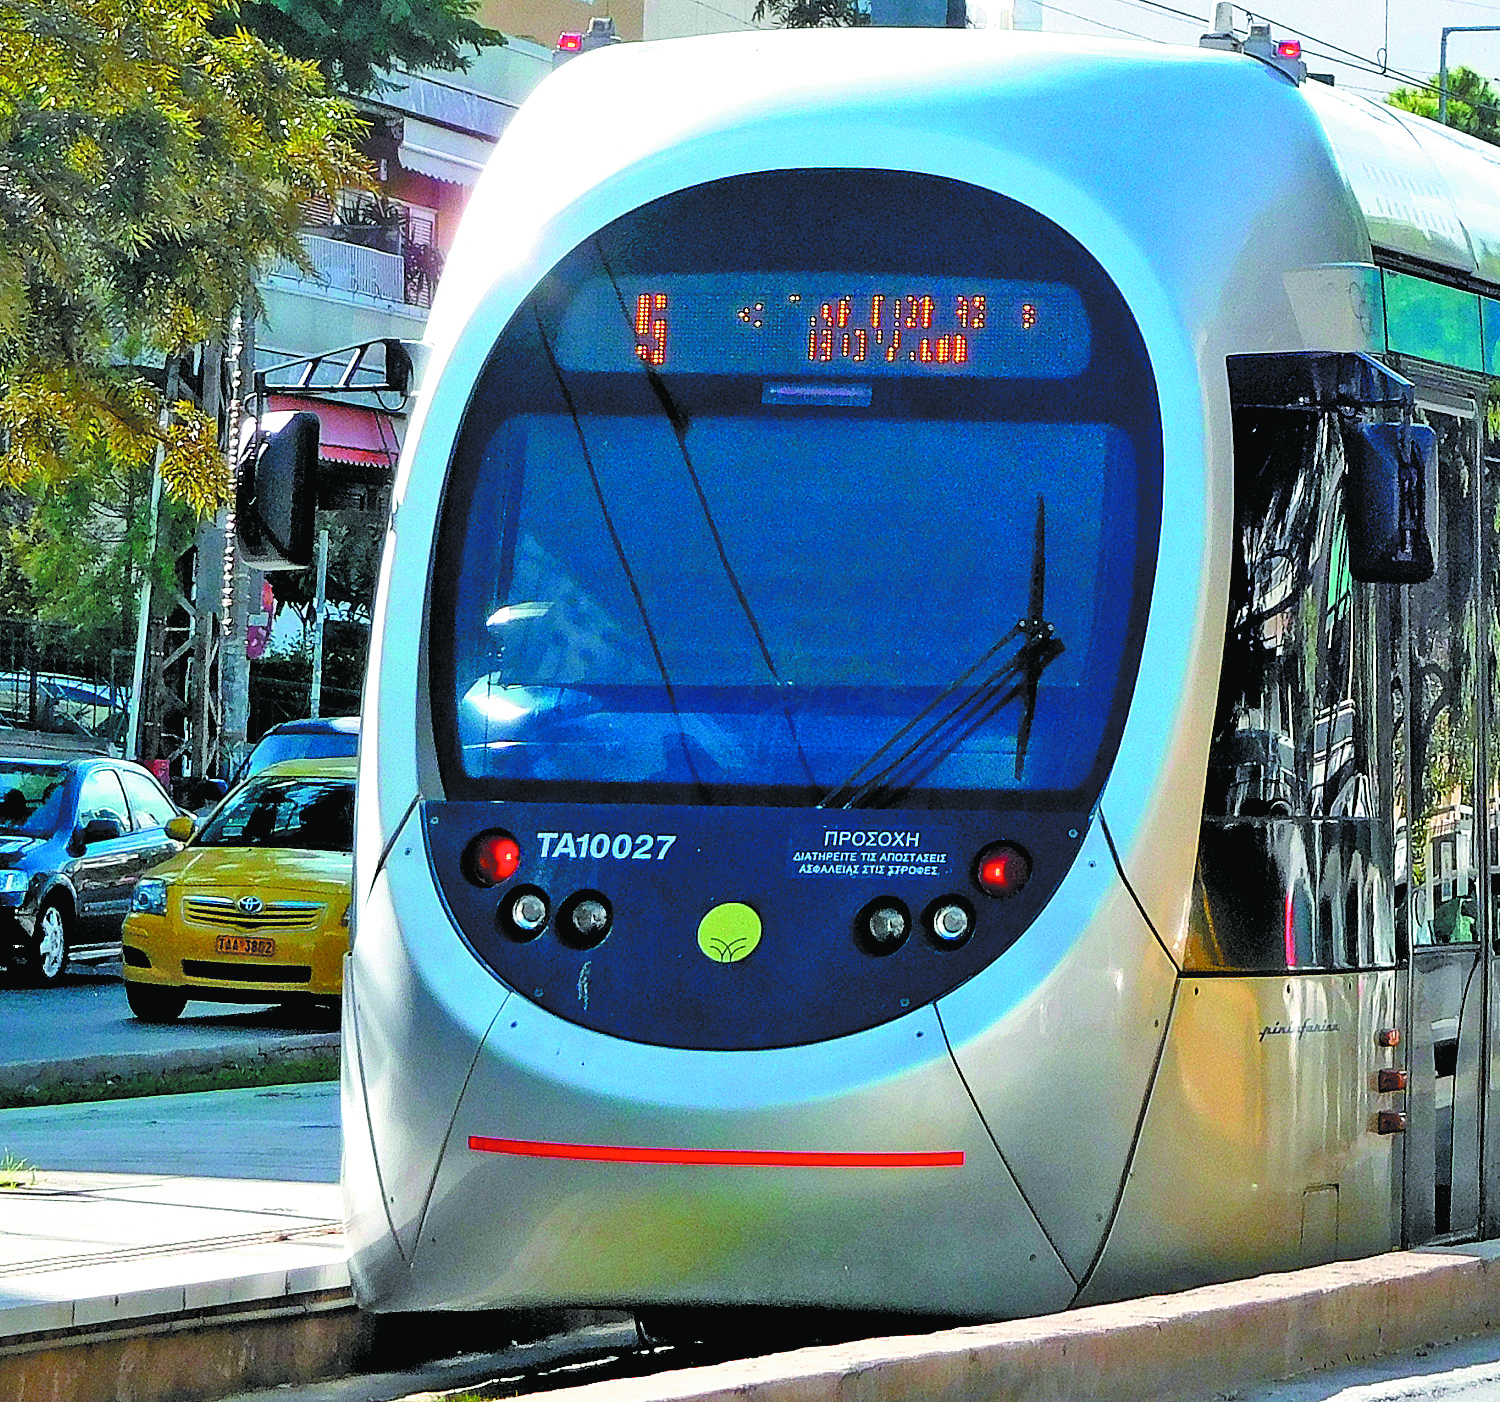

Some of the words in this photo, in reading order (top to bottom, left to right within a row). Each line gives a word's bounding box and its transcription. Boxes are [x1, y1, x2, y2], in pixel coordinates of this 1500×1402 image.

[824, 830, 920, 847] ΠΡΟΣΟΧΗ
[537, 832, 677, 860] TA10027
[792, 851, 858, 862] ΔΙΑΤΗΡΕΙΤΕ
[860, 852, 878, 862] ΤΙΣ
[879, 852, 947, 863] ΑΠΟΣΤΑΣΕΙΣ
[798, 863, 859, 875] ΑΣΦΑΛΕΙΑΣ
[861, 864, 886, 875] ΣΤΙΣ
